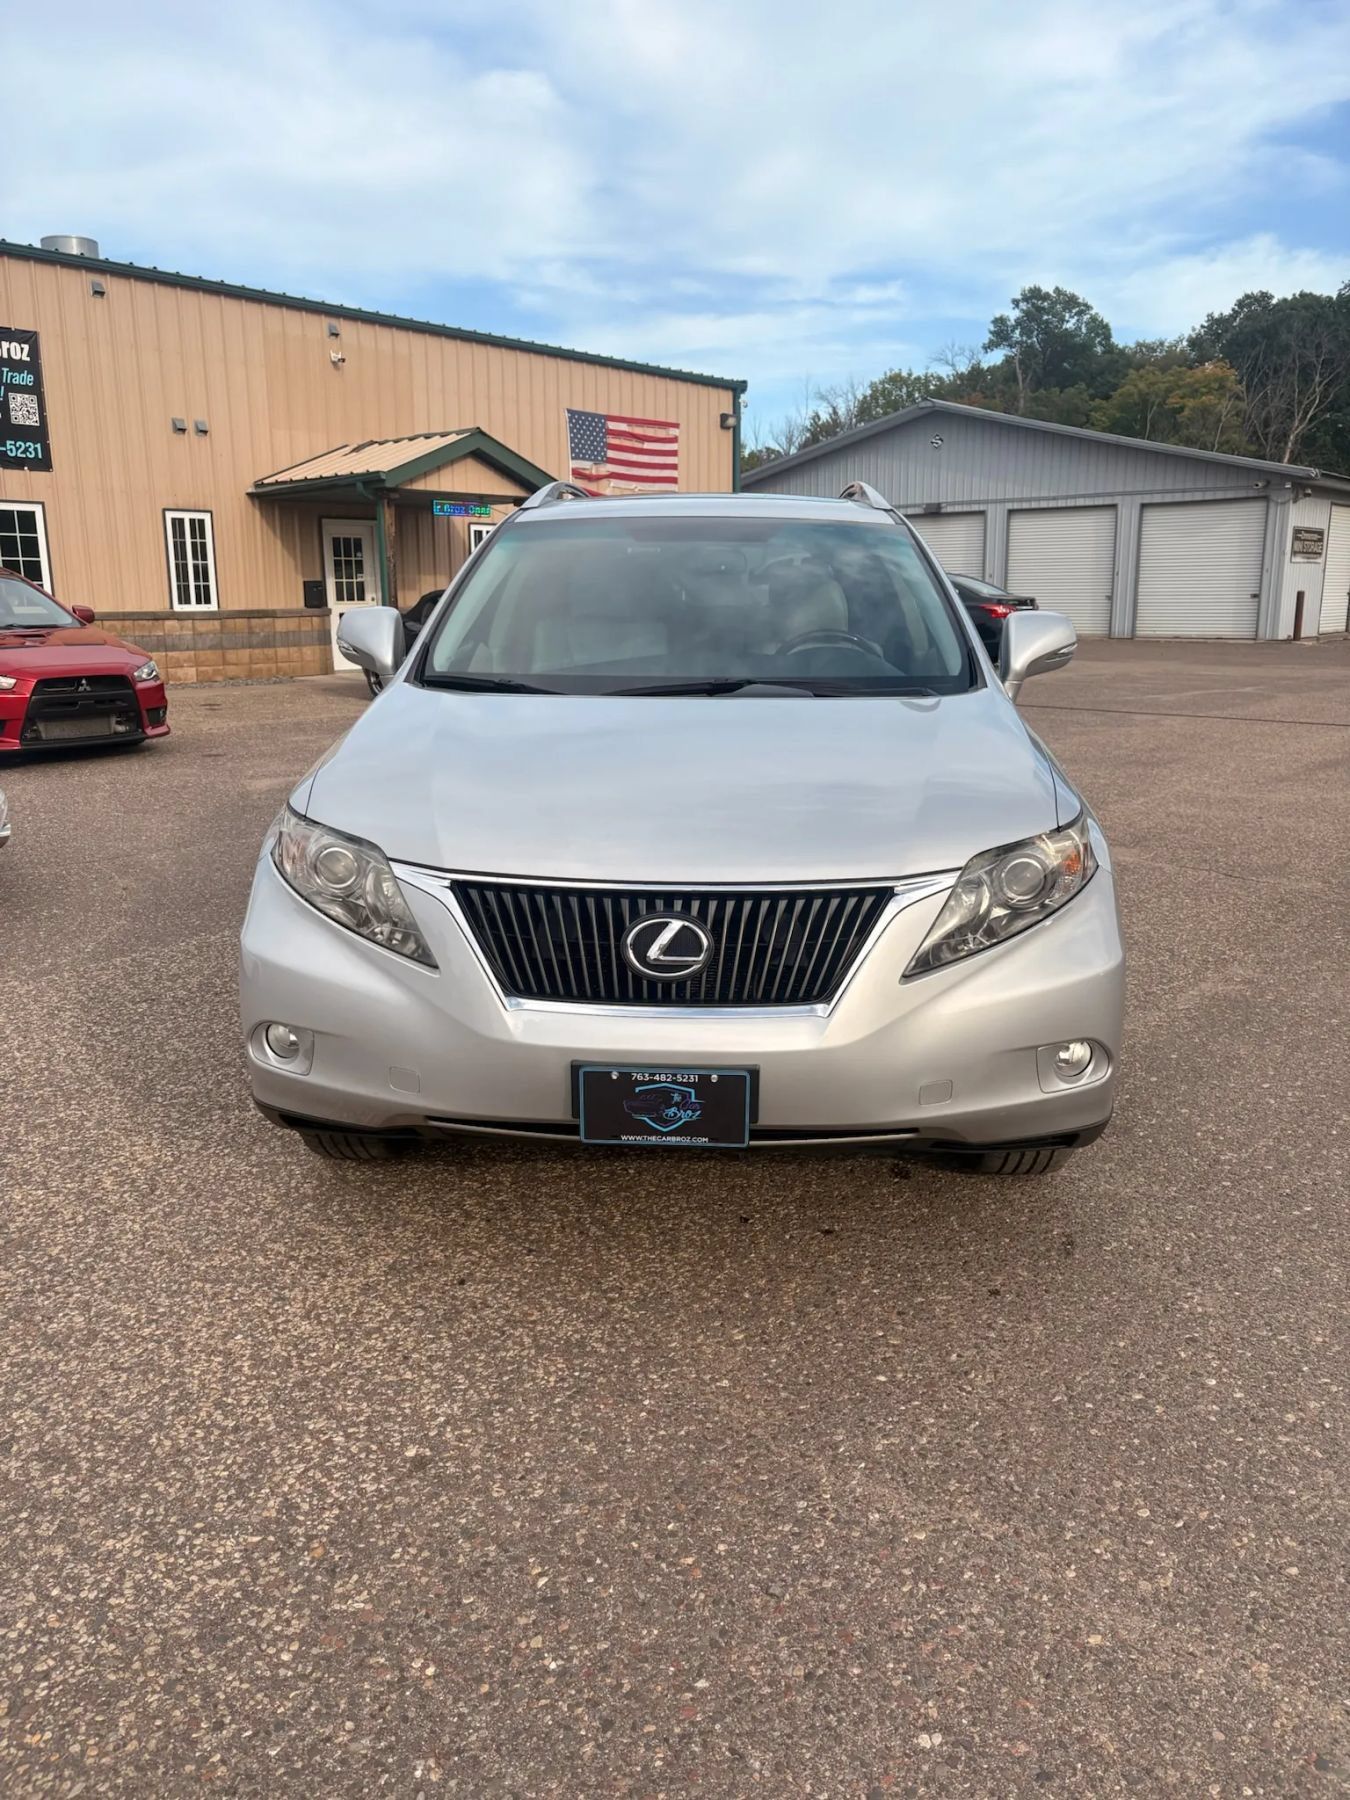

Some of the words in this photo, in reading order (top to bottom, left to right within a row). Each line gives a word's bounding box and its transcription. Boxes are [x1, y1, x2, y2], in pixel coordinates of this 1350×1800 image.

[0, 340, 30, 361] roz
[2, 367, 34, 386] Trade
[631, 1073, 699, 1083] 763-482-5231
[621, 1135, 709, 1143] WWW.THECARBROZ.COM
